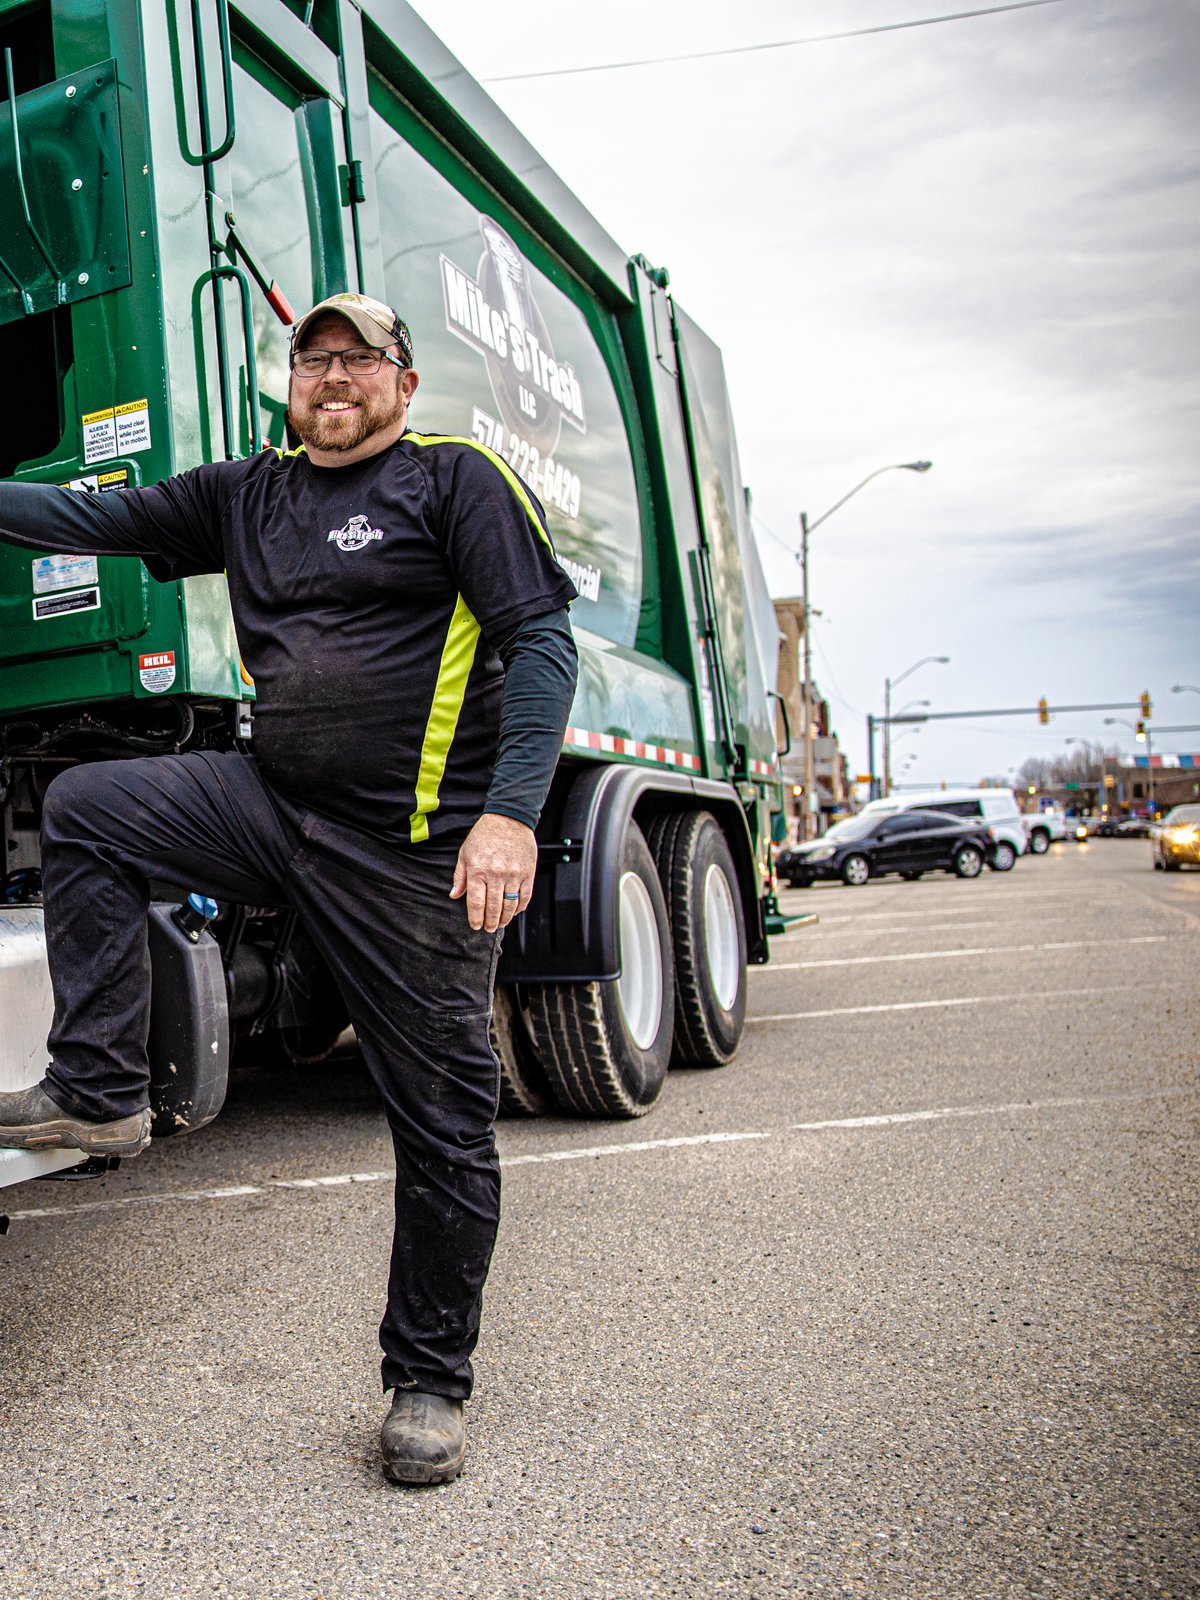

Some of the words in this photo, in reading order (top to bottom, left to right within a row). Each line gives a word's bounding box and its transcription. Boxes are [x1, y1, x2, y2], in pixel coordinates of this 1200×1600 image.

[443, 259, 526, 374] Mike's
[525, 329, 585, 421] Trash
[121, 401, 147, 413] CAUTION
[519, 384, 537, 420] LLC
[118, 422, 133, 431] Stand
[133, 419, 145, 427] clear
[119, 431, 132, 439] while
[132, 427, 146, 436] panel
[103, 471, 126, 482] CAUTION
[143, 655, 171, 667] HEIL
